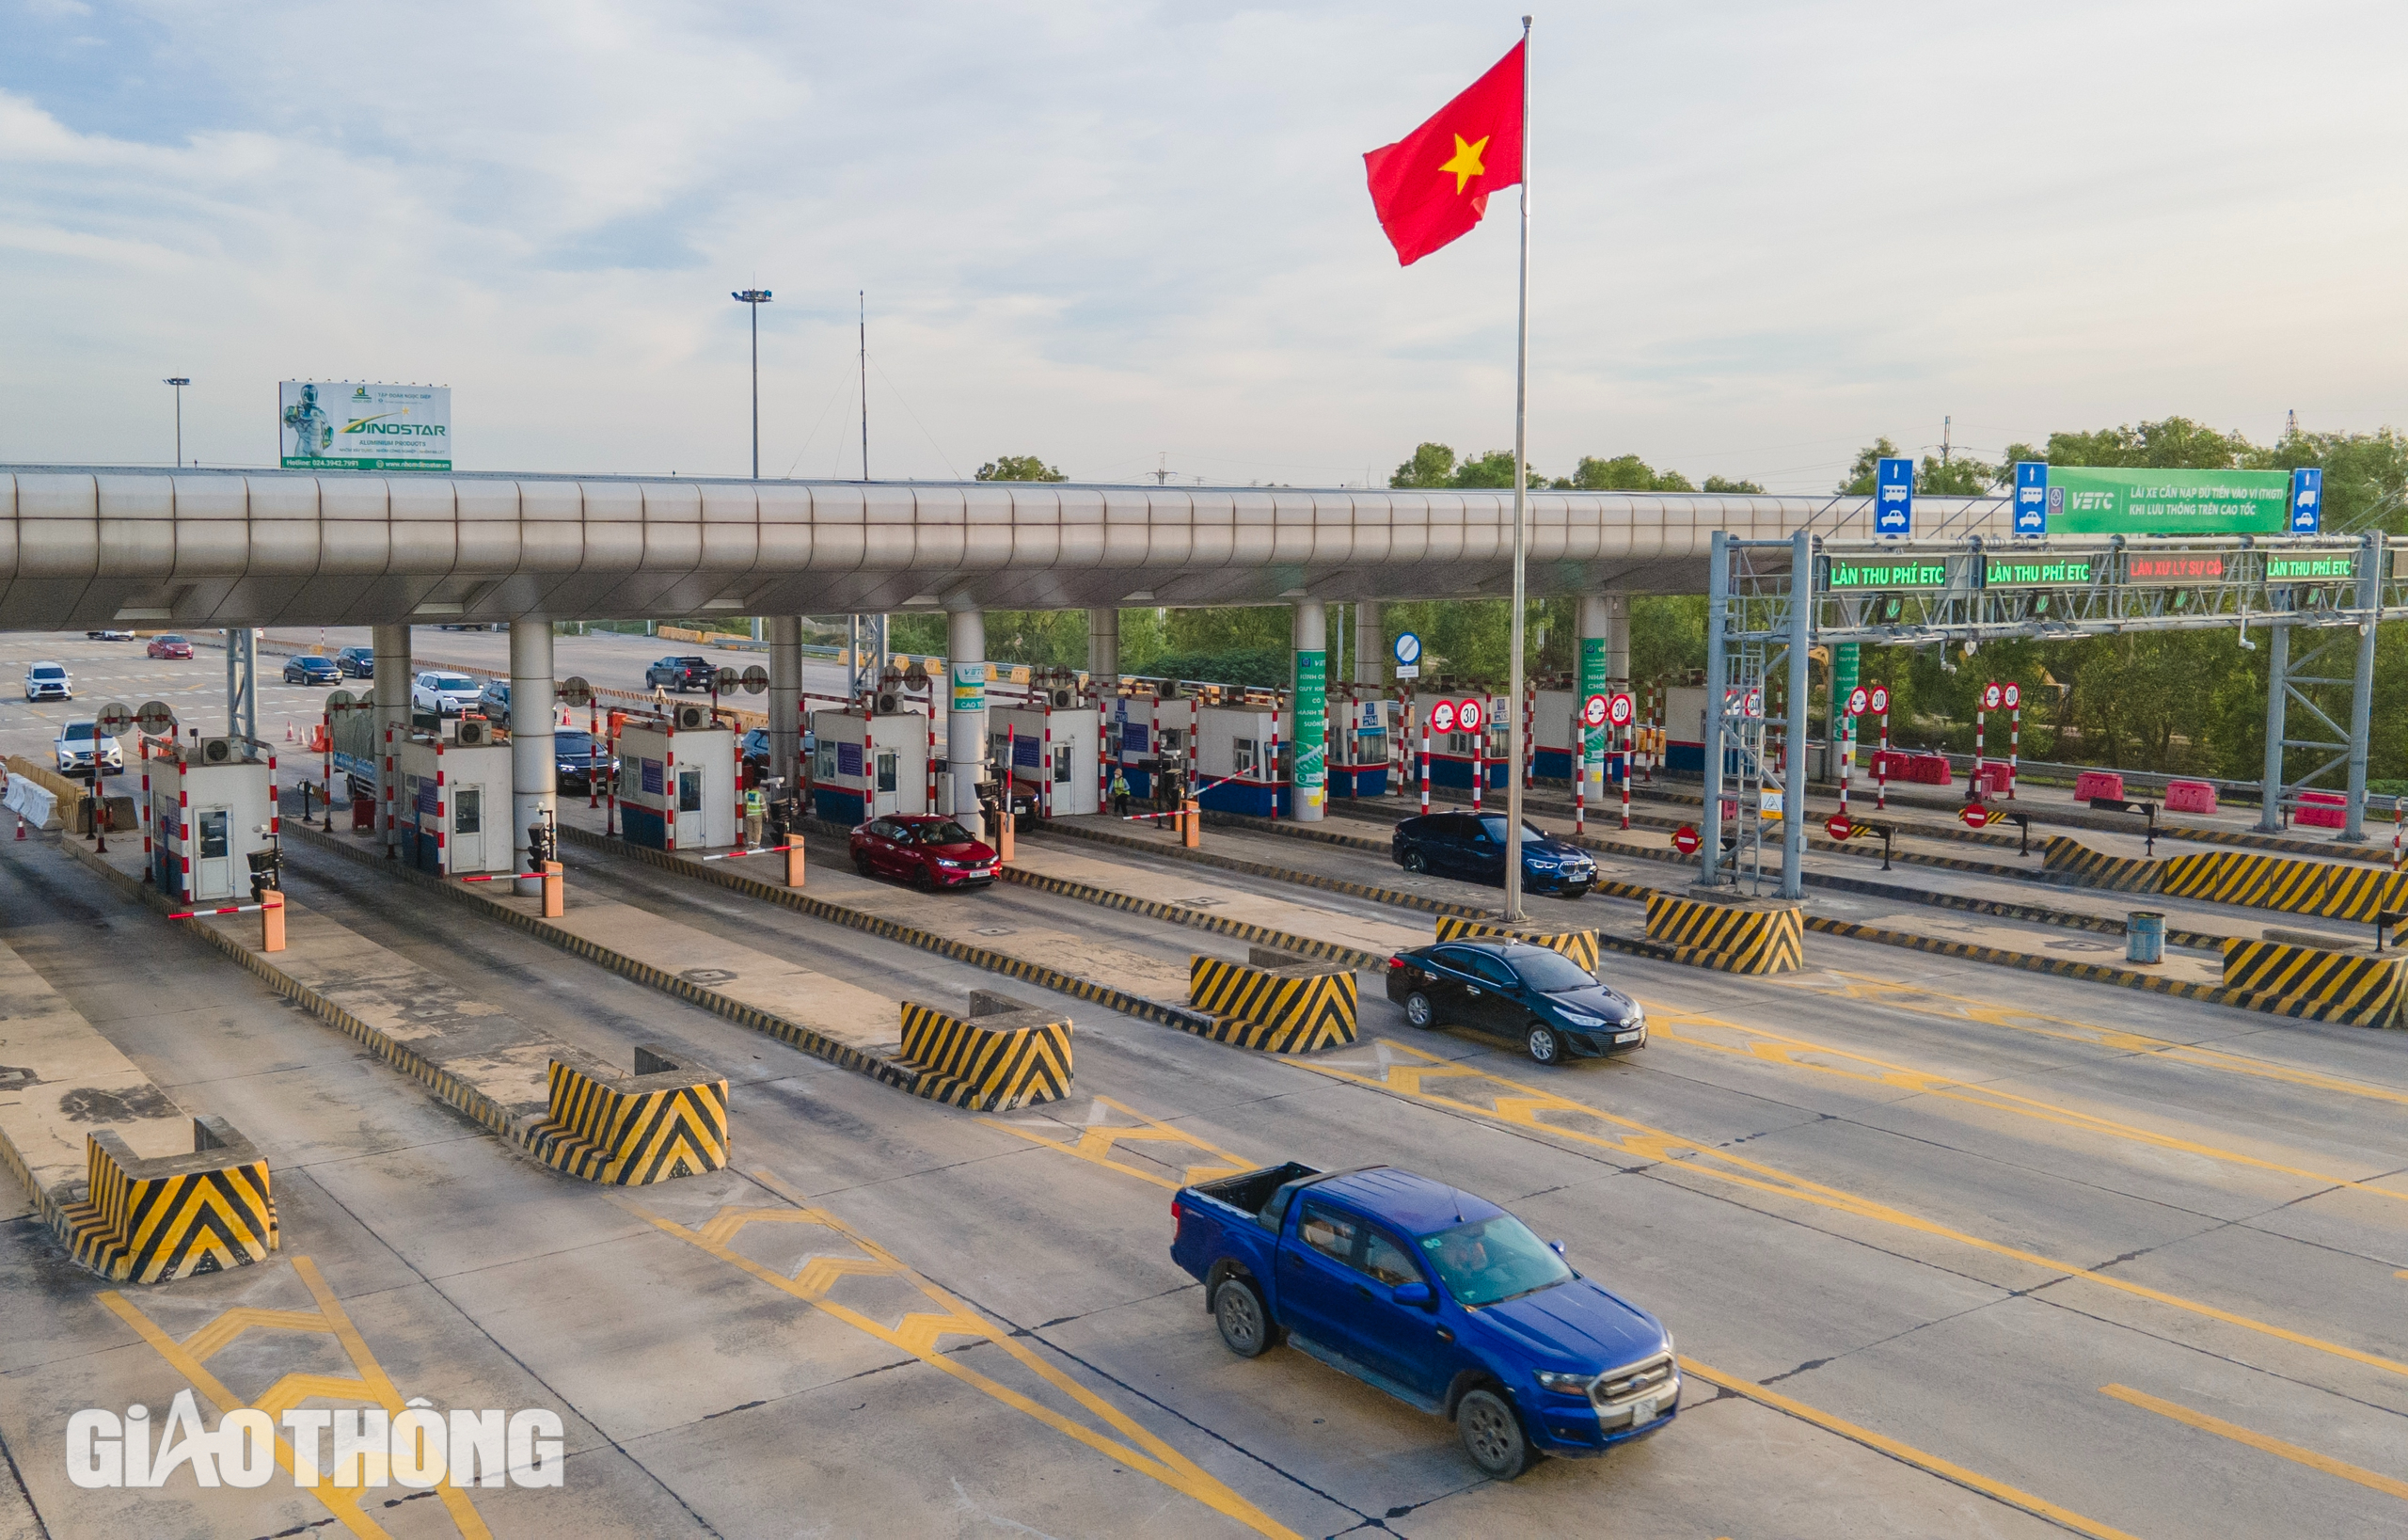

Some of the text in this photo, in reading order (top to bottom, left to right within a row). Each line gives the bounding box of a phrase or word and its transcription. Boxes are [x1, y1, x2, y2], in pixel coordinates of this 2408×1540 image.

[341, 418, 446, 437] DINOSTAR
[2072, 491, 2115, 510] VETC
[2131, 484, 2145, 499] LÁI
[2146, 487, 2158, 499] XE
[2178, 487, 2197, 501] NẠP
[2258, 487, 2284, 500] (TKGT)
[2129, 504, 2145, 516] KHI
[2165, 501, 2196, 516] THÔNG
[2198, 501, 2219, 516] TRÊN
[2220, 504, 2238, 516] CAO
[2240, 500, 2257, 516] TỐC
[1831, 562, 1944, 585] LÀN THU PHÍ ETC
[1988, 560, 2089, 582] LÀN THU PHÍ ETC
[2172, 557, 2188, 576] LÝ
[2267, 556, 2351, 576] LÀN THU PHÍ ETC
[1874, 693, 1884, 707] 30
[2007, 690, 2016, 703] 30
[1463, 707, 1476, 723] 30
[1614, 703, 1626, 718] 30
